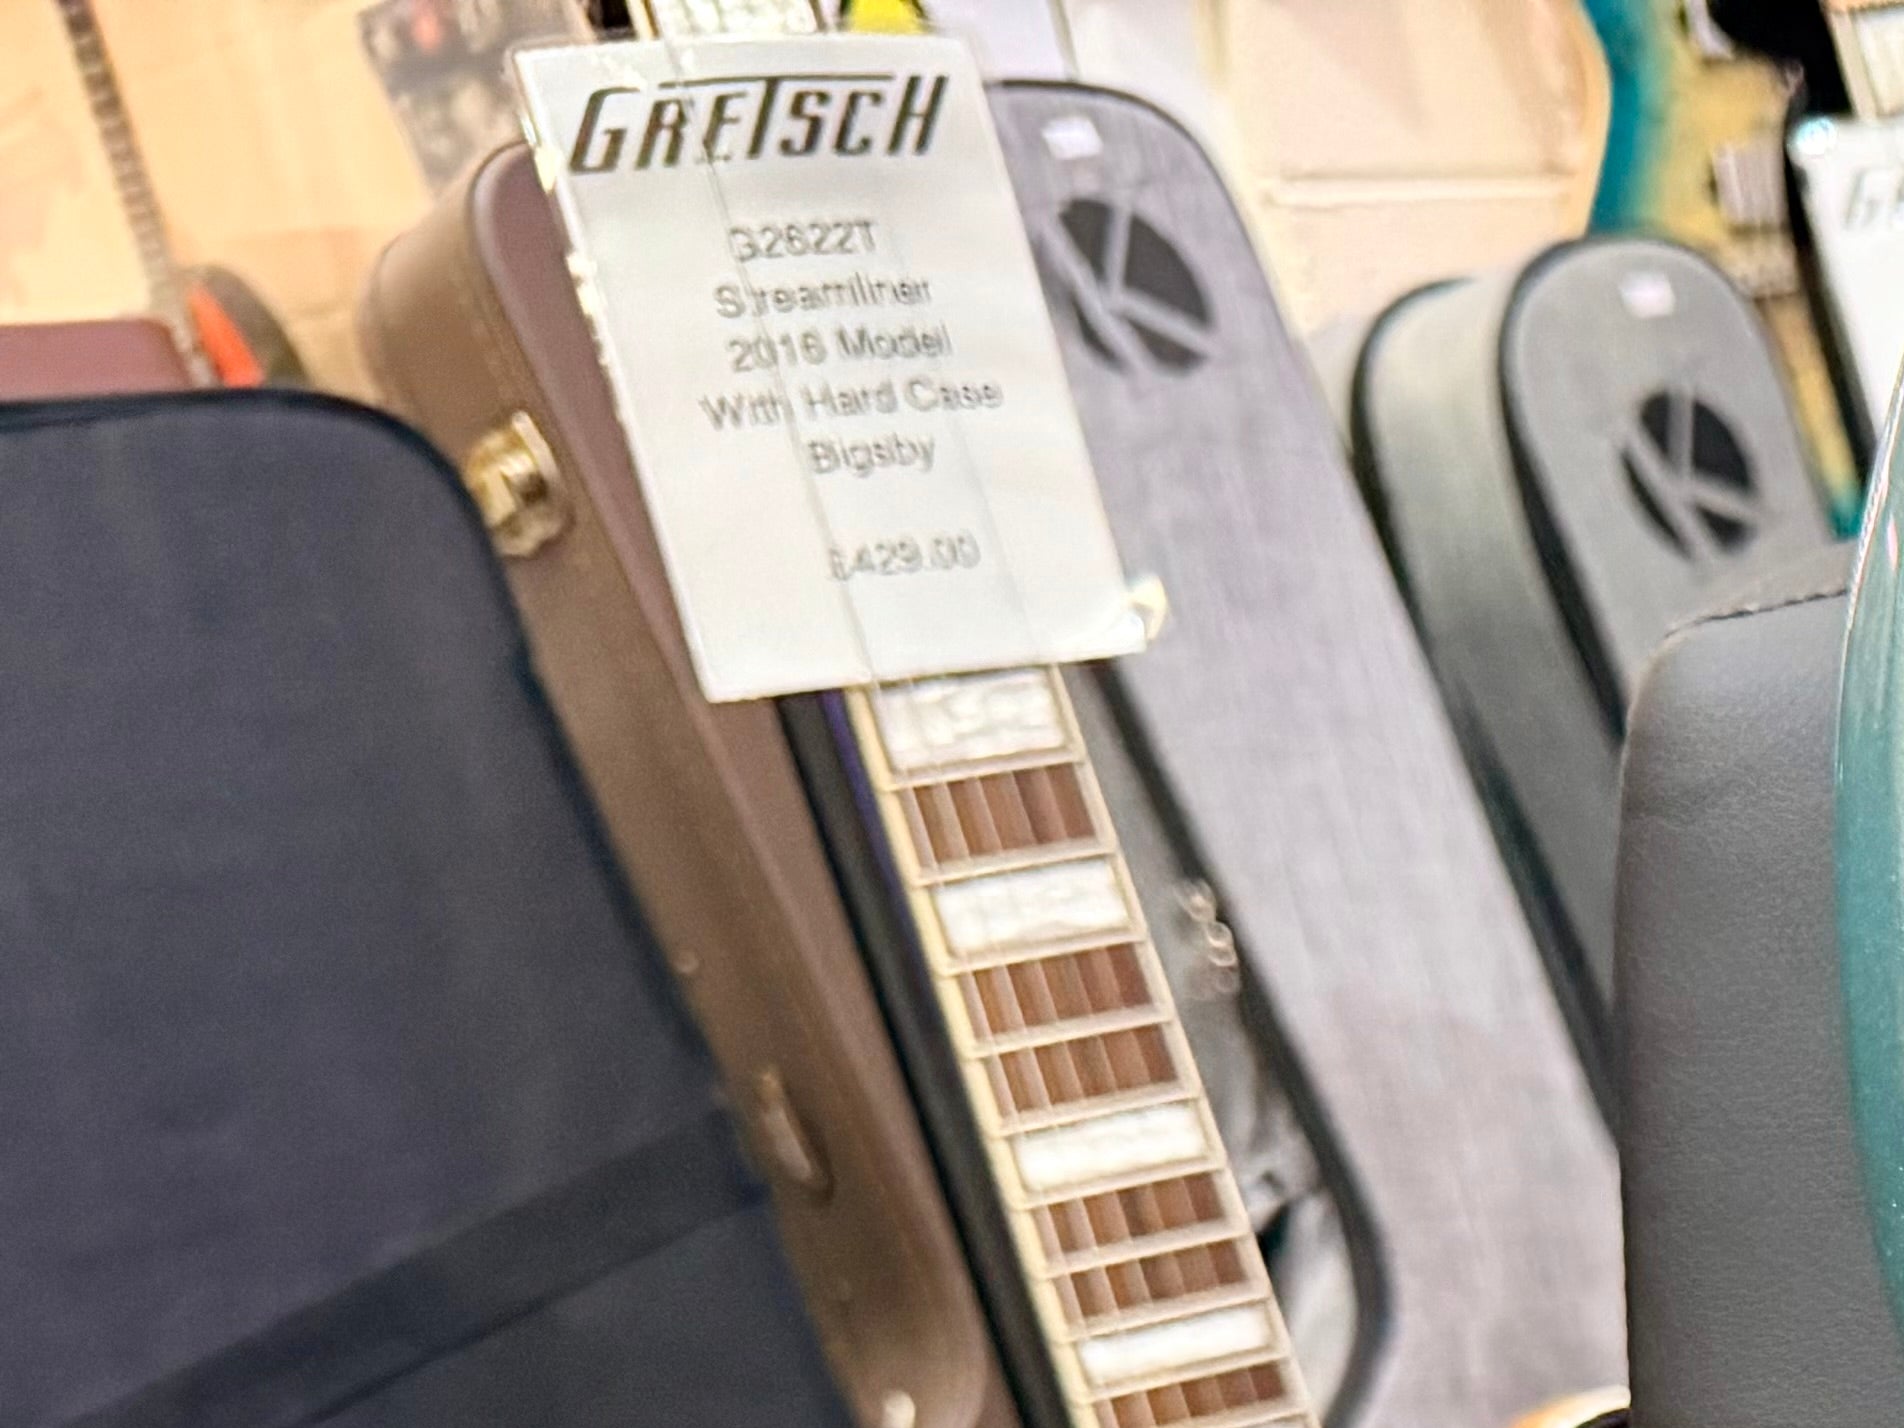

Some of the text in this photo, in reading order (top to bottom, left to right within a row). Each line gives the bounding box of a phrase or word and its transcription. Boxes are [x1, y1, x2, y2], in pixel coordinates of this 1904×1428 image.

[568, 73, 949, 176] GRETSCH
[729, 320, 953, 372] 2016 Model
[801, 379, 898, 417] Hard
[904, 374, 1003, 412] Case
[809, 433, 935, 478] Bigsby
